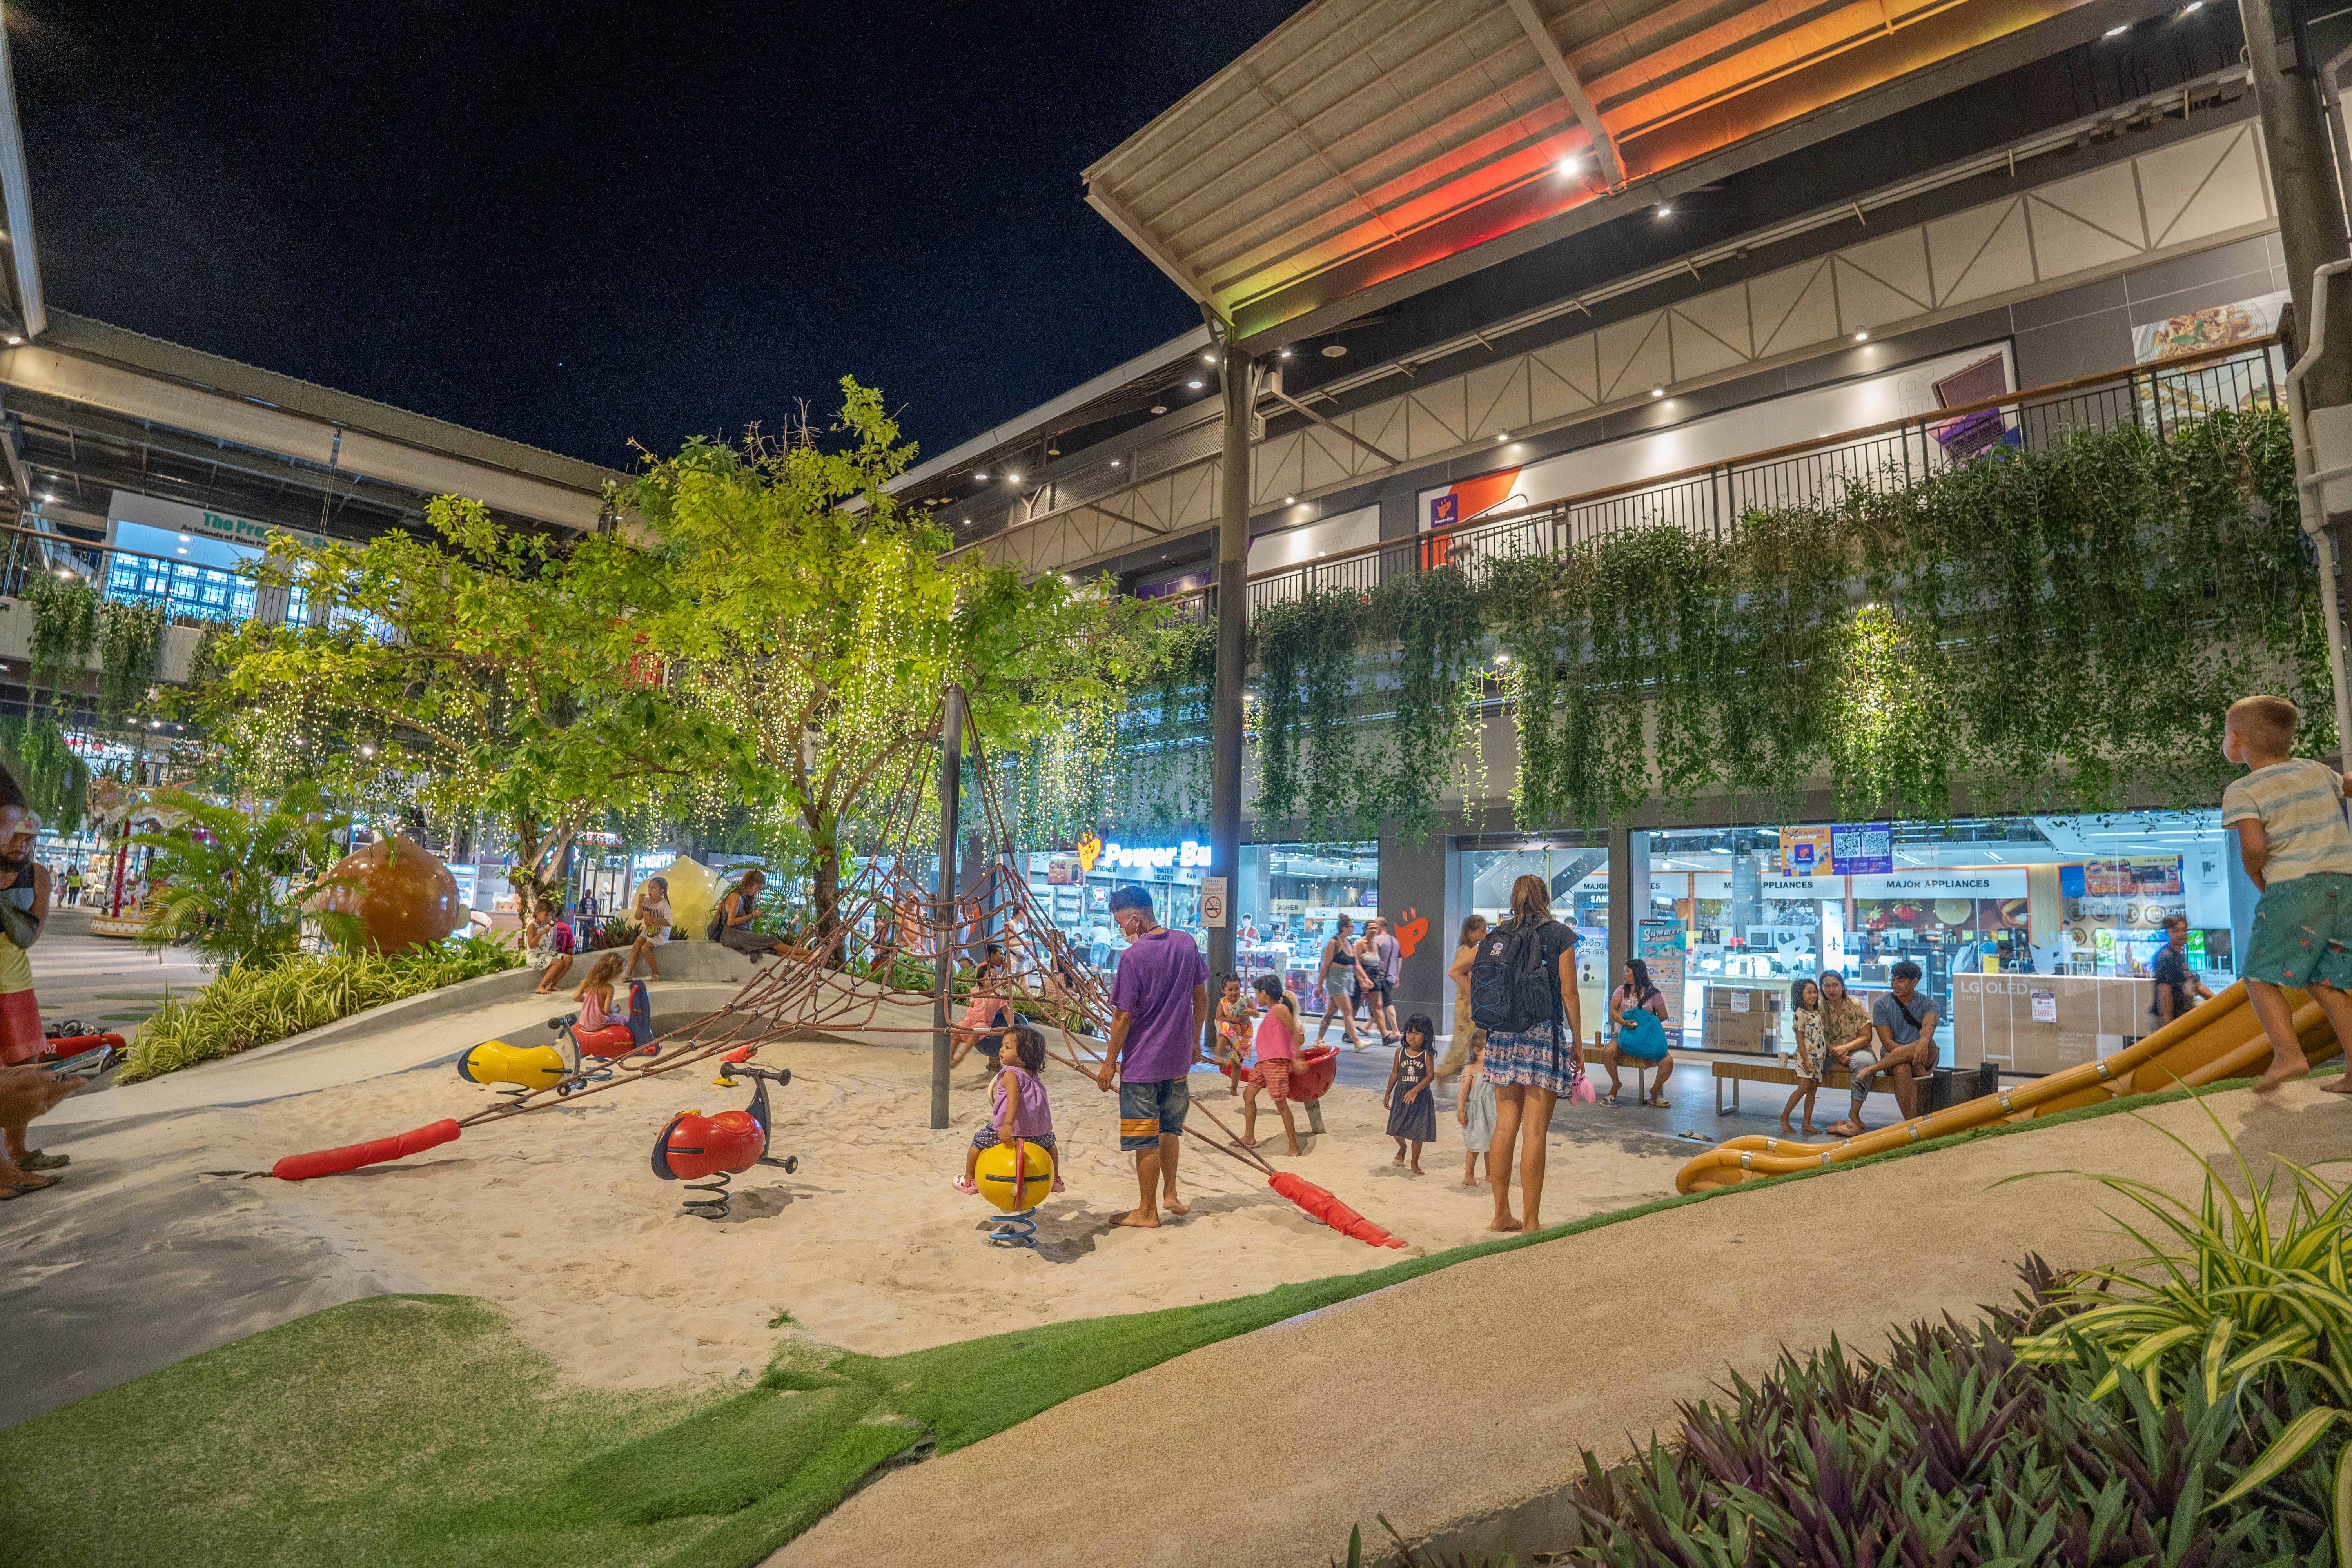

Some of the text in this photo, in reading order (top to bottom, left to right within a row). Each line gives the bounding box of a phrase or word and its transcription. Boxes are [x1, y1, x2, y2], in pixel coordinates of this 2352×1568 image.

[203, 512, 233, 531] The
[194, 527, 223, 539] Islands
[234, 536, 254, 546] Siam
[1105, 841, 1212, 867] Power Bu
[1924, 880, 1990, 888] APPLIANCES
[1590, 895, 1609, 903] SAM
[1642, 927, 1682, 942] Summer
[1960, 981, 2027, 995] LG OLED
[44, 1044, 57, 1053] 02
[1400, 1060, 1425, 1069] UNICORN
